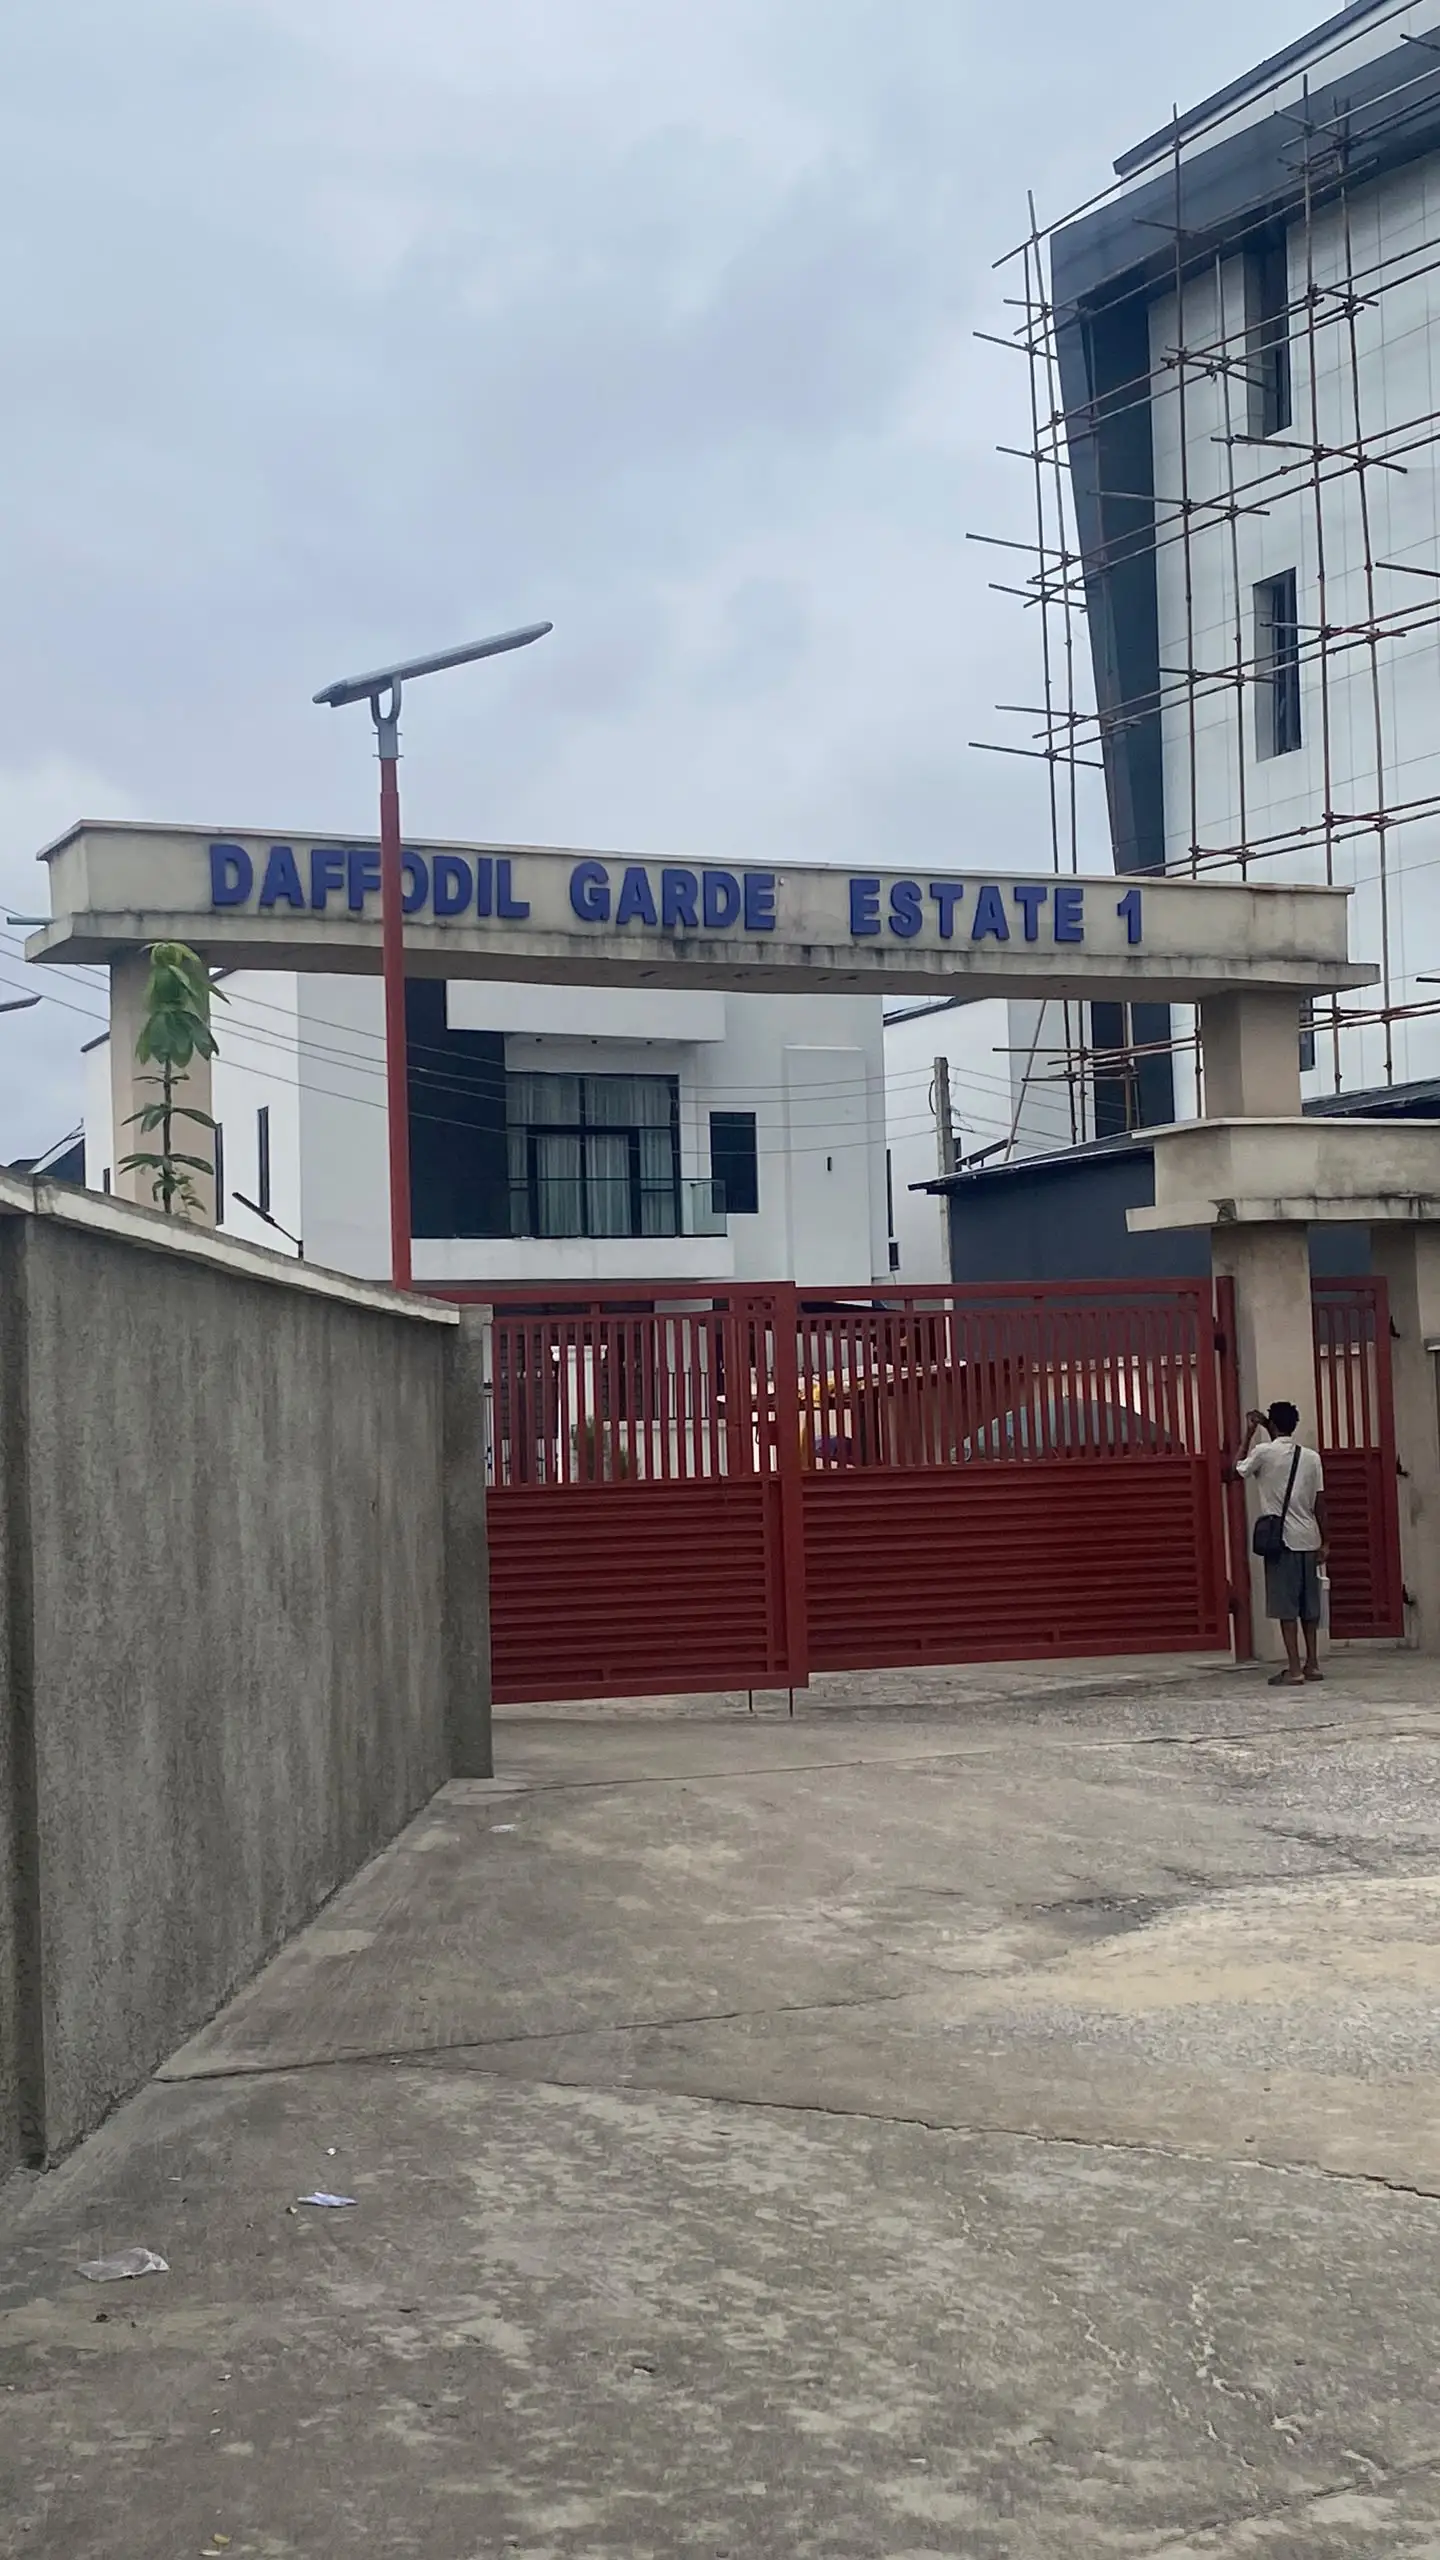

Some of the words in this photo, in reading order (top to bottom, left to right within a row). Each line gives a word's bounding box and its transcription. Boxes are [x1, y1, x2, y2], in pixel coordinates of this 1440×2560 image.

[209, 843, 530, 918] DAFFODIL
[569, 861, 776, 931] GARDE
[849, 878, 1085, 943] ESTATE
[1116, 889, 1142, 945] 1
